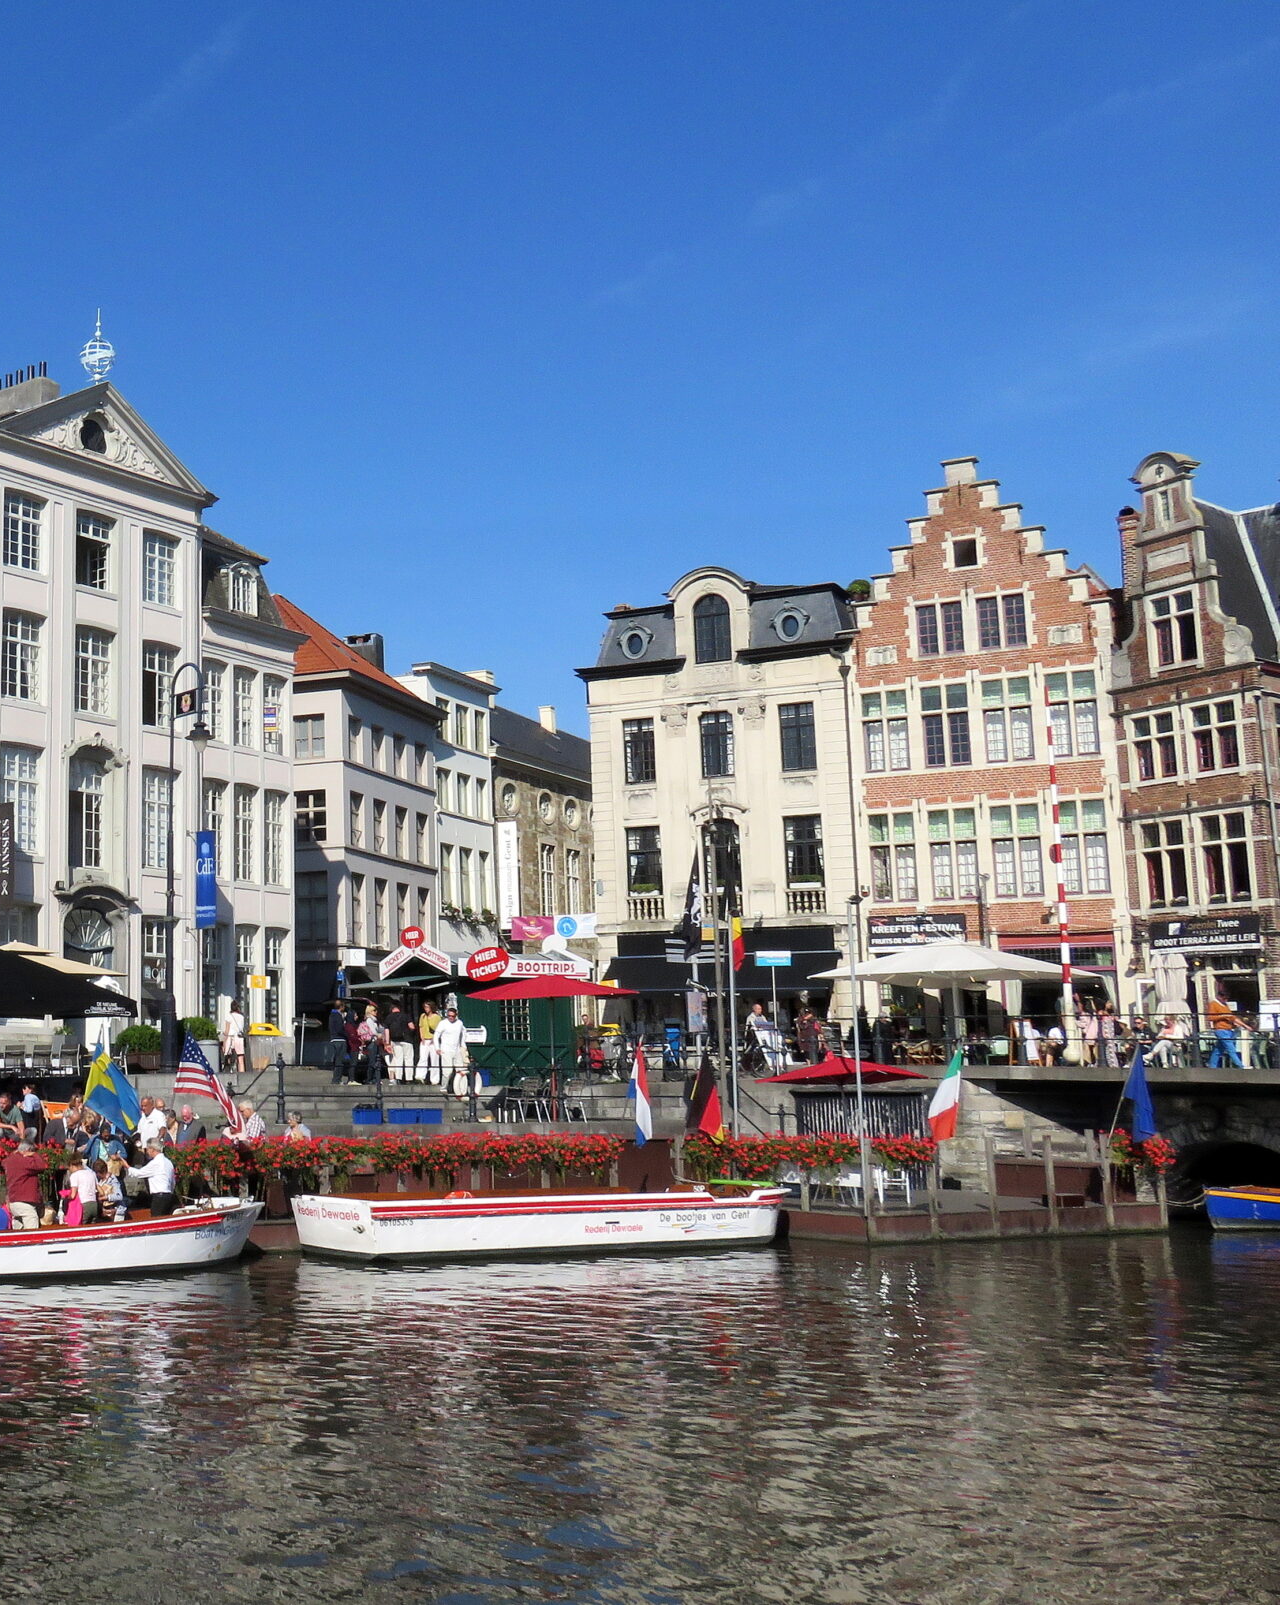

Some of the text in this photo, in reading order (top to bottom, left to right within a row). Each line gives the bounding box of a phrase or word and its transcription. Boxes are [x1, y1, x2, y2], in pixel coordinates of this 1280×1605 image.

[871, 924, 919, 934] KREEFTEN
[919, 923, 963, 932] FESTIVAL
[405, 931, 419, 941] HIER
[1153, 933, 1257, 947] GROOT TERRAS AAN DE LEIE
[384, 949, 405, 969] TICKETS
[420, 945, 449, 966] BOOTTRIPS
[474, 949, 498, 963] HIER
[470, 960, 506, 980] TICKETS
[517, 962, 575, 974] BOOTTRIPS
[321, 1207, 360, 1221] Dewaele
[659, 1213, 671, 1223] De
[711, 1211, 727, 1221] van
[731, 1210, 750, 1219] Gent
[584, 1224, 610, 1234] Rederij
